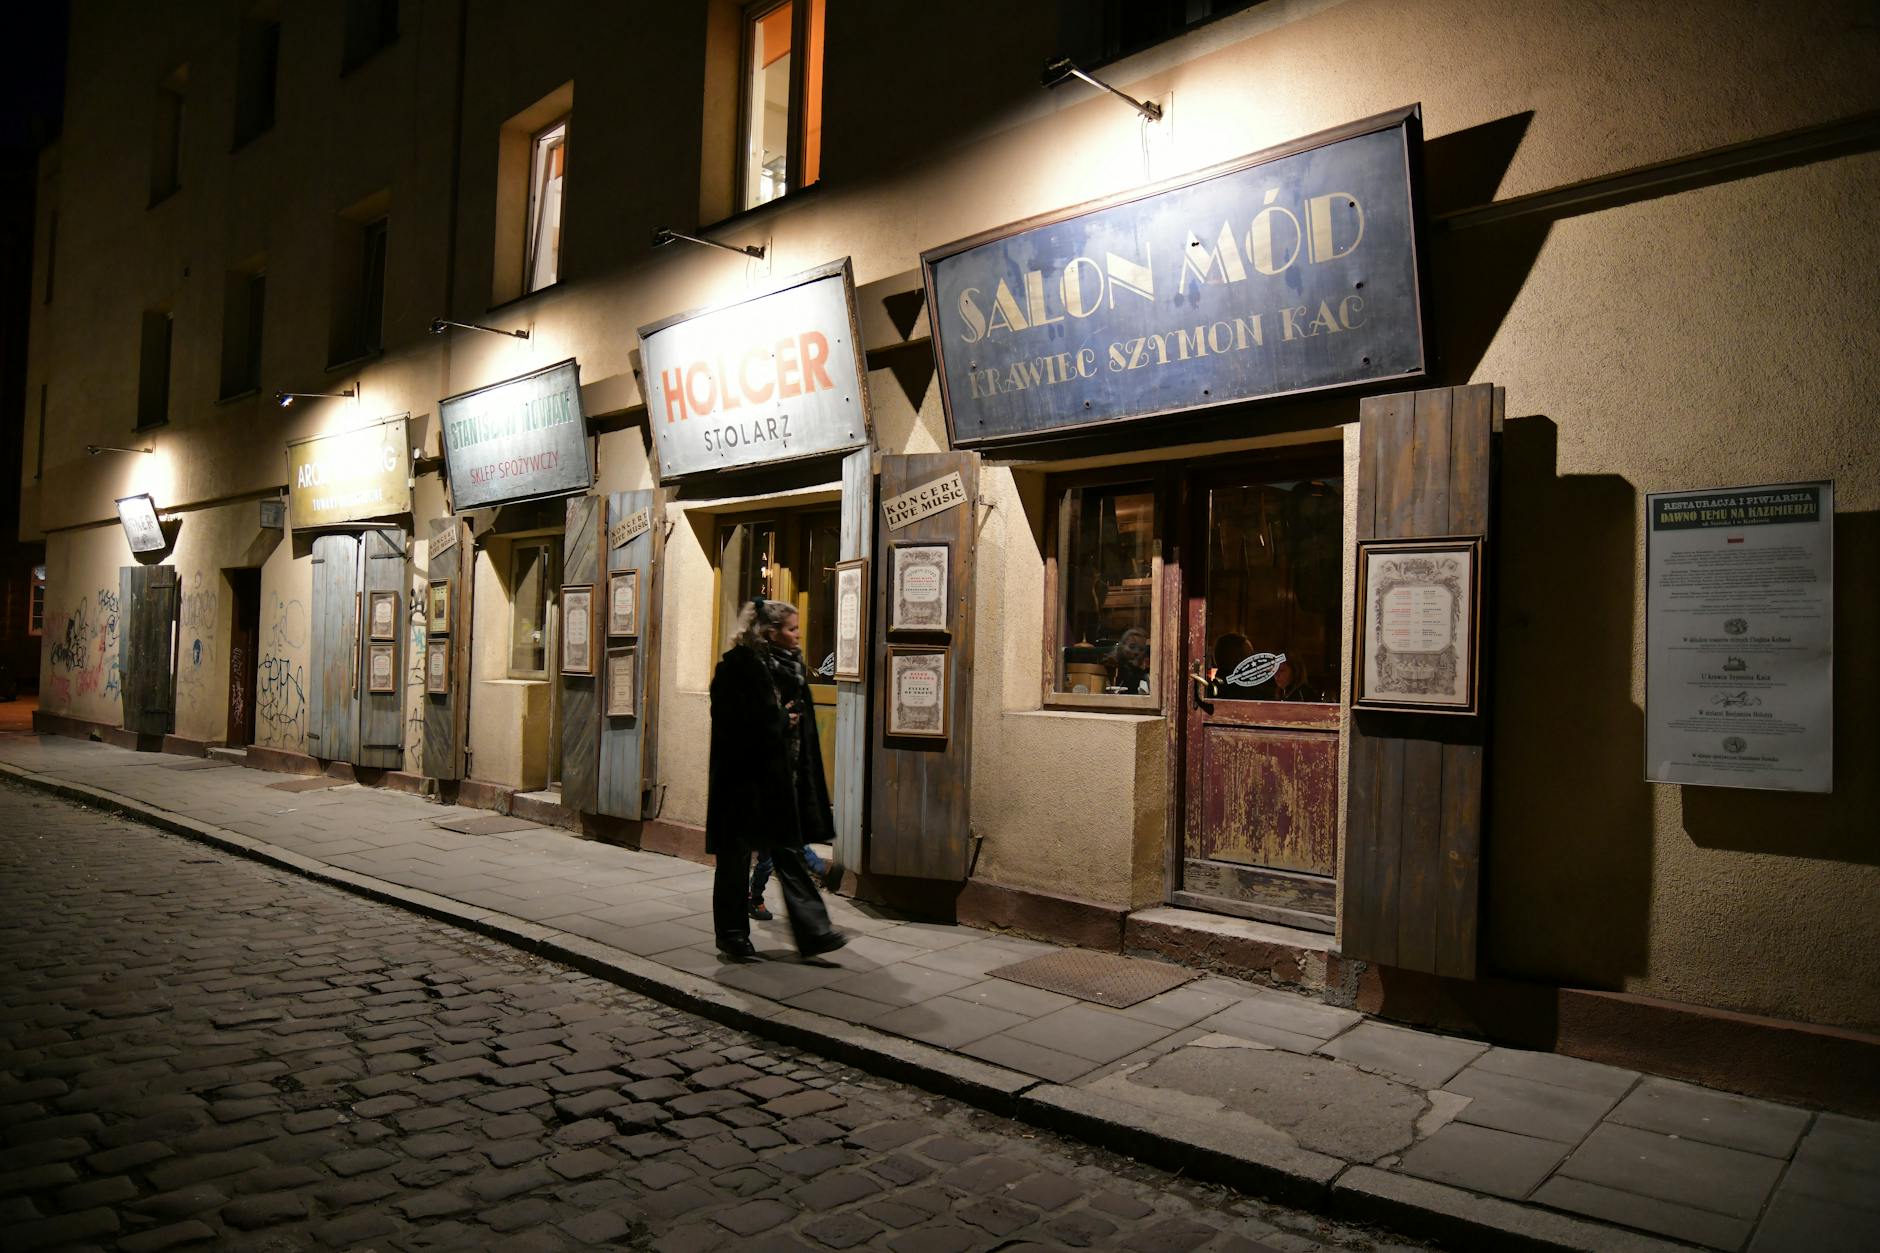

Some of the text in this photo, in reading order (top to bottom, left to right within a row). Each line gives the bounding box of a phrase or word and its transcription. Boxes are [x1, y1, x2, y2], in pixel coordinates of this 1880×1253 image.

[959, 187, 1365, 344] SALON MÓD
[968, 295, 1367, 399] KRAWIEC SZYMON KAC
[661, 330, 836, 424] HOLCER
[704, 414, 793, 451] STOLARZ
[470, 450, 560, 485] SKLEP SPOŻYWCZY
[886, 478, 959, 515] KONCERT
[889, 489, 963, 525] LIVE MUSIC
[1660, 511, 1697, 524] DAWNO
[1701, 509, 1728, 521] TEMU
[1731, 508, 1745, 519] NA
[1750, 503, 1818, 518] KAZIMIERZU
[1664, 493, 1813, 511] RESTAURACJA I PIWIARNIA
[611, 512, 647, 537] KONCERT
[612, 520, 649, 546] LIVE MUSIC
